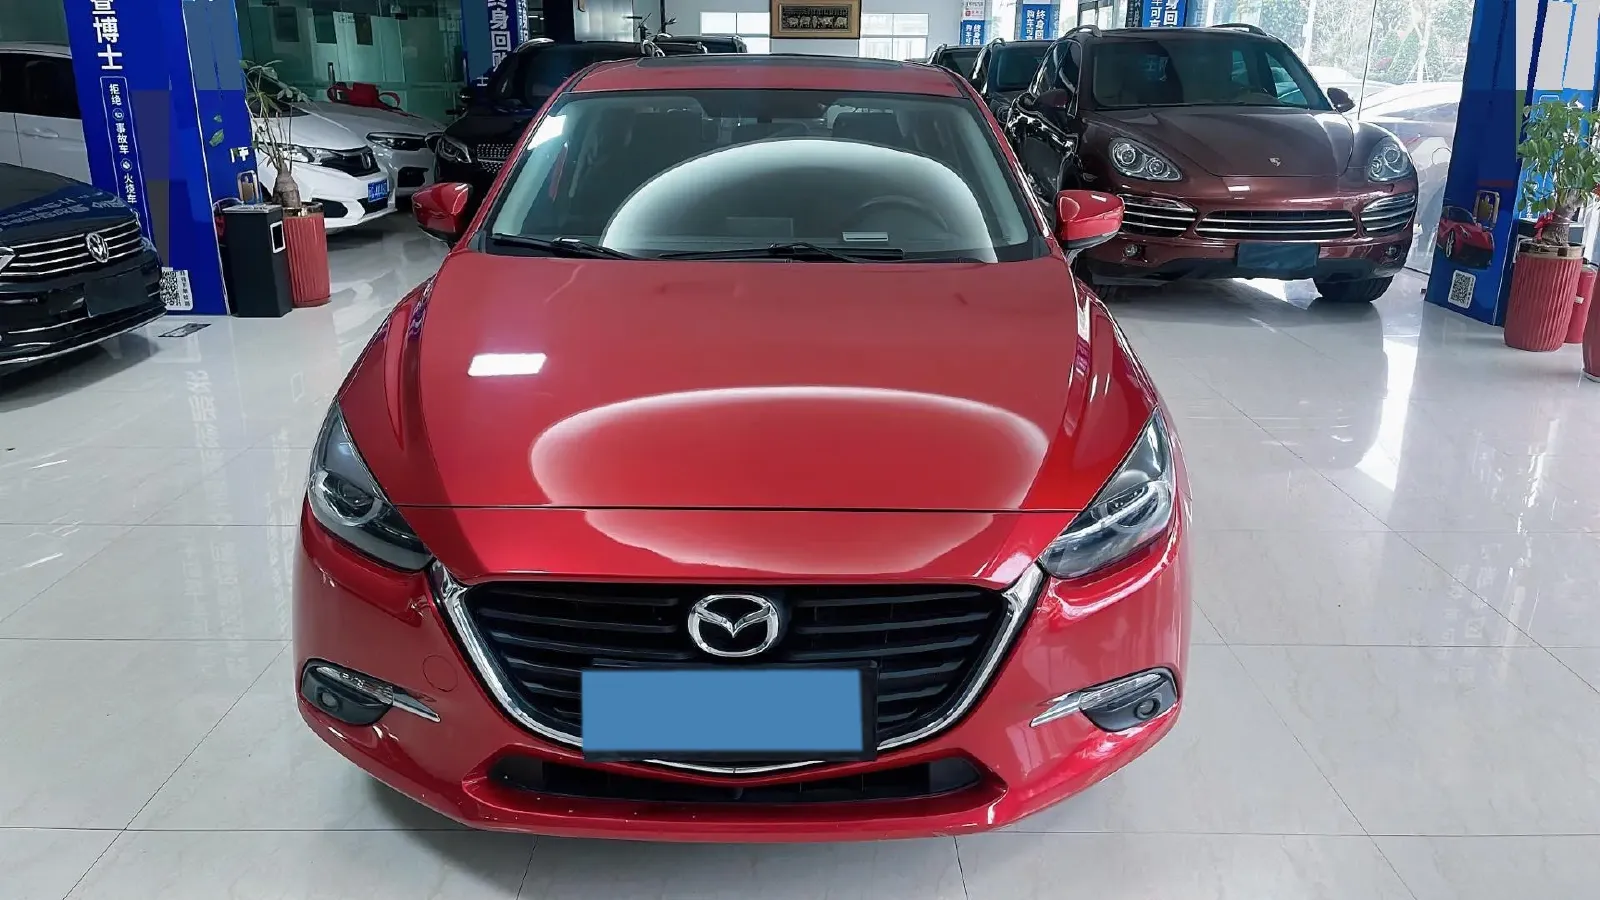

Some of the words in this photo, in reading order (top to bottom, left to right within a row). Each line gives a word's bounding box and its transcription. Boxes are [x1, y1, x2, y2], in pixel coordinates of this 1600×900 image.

[109, 83, 123, 106] 拒绝
[115, 122, 130, 154] 事故车
[124, 172, 138, 204] 火烧车
